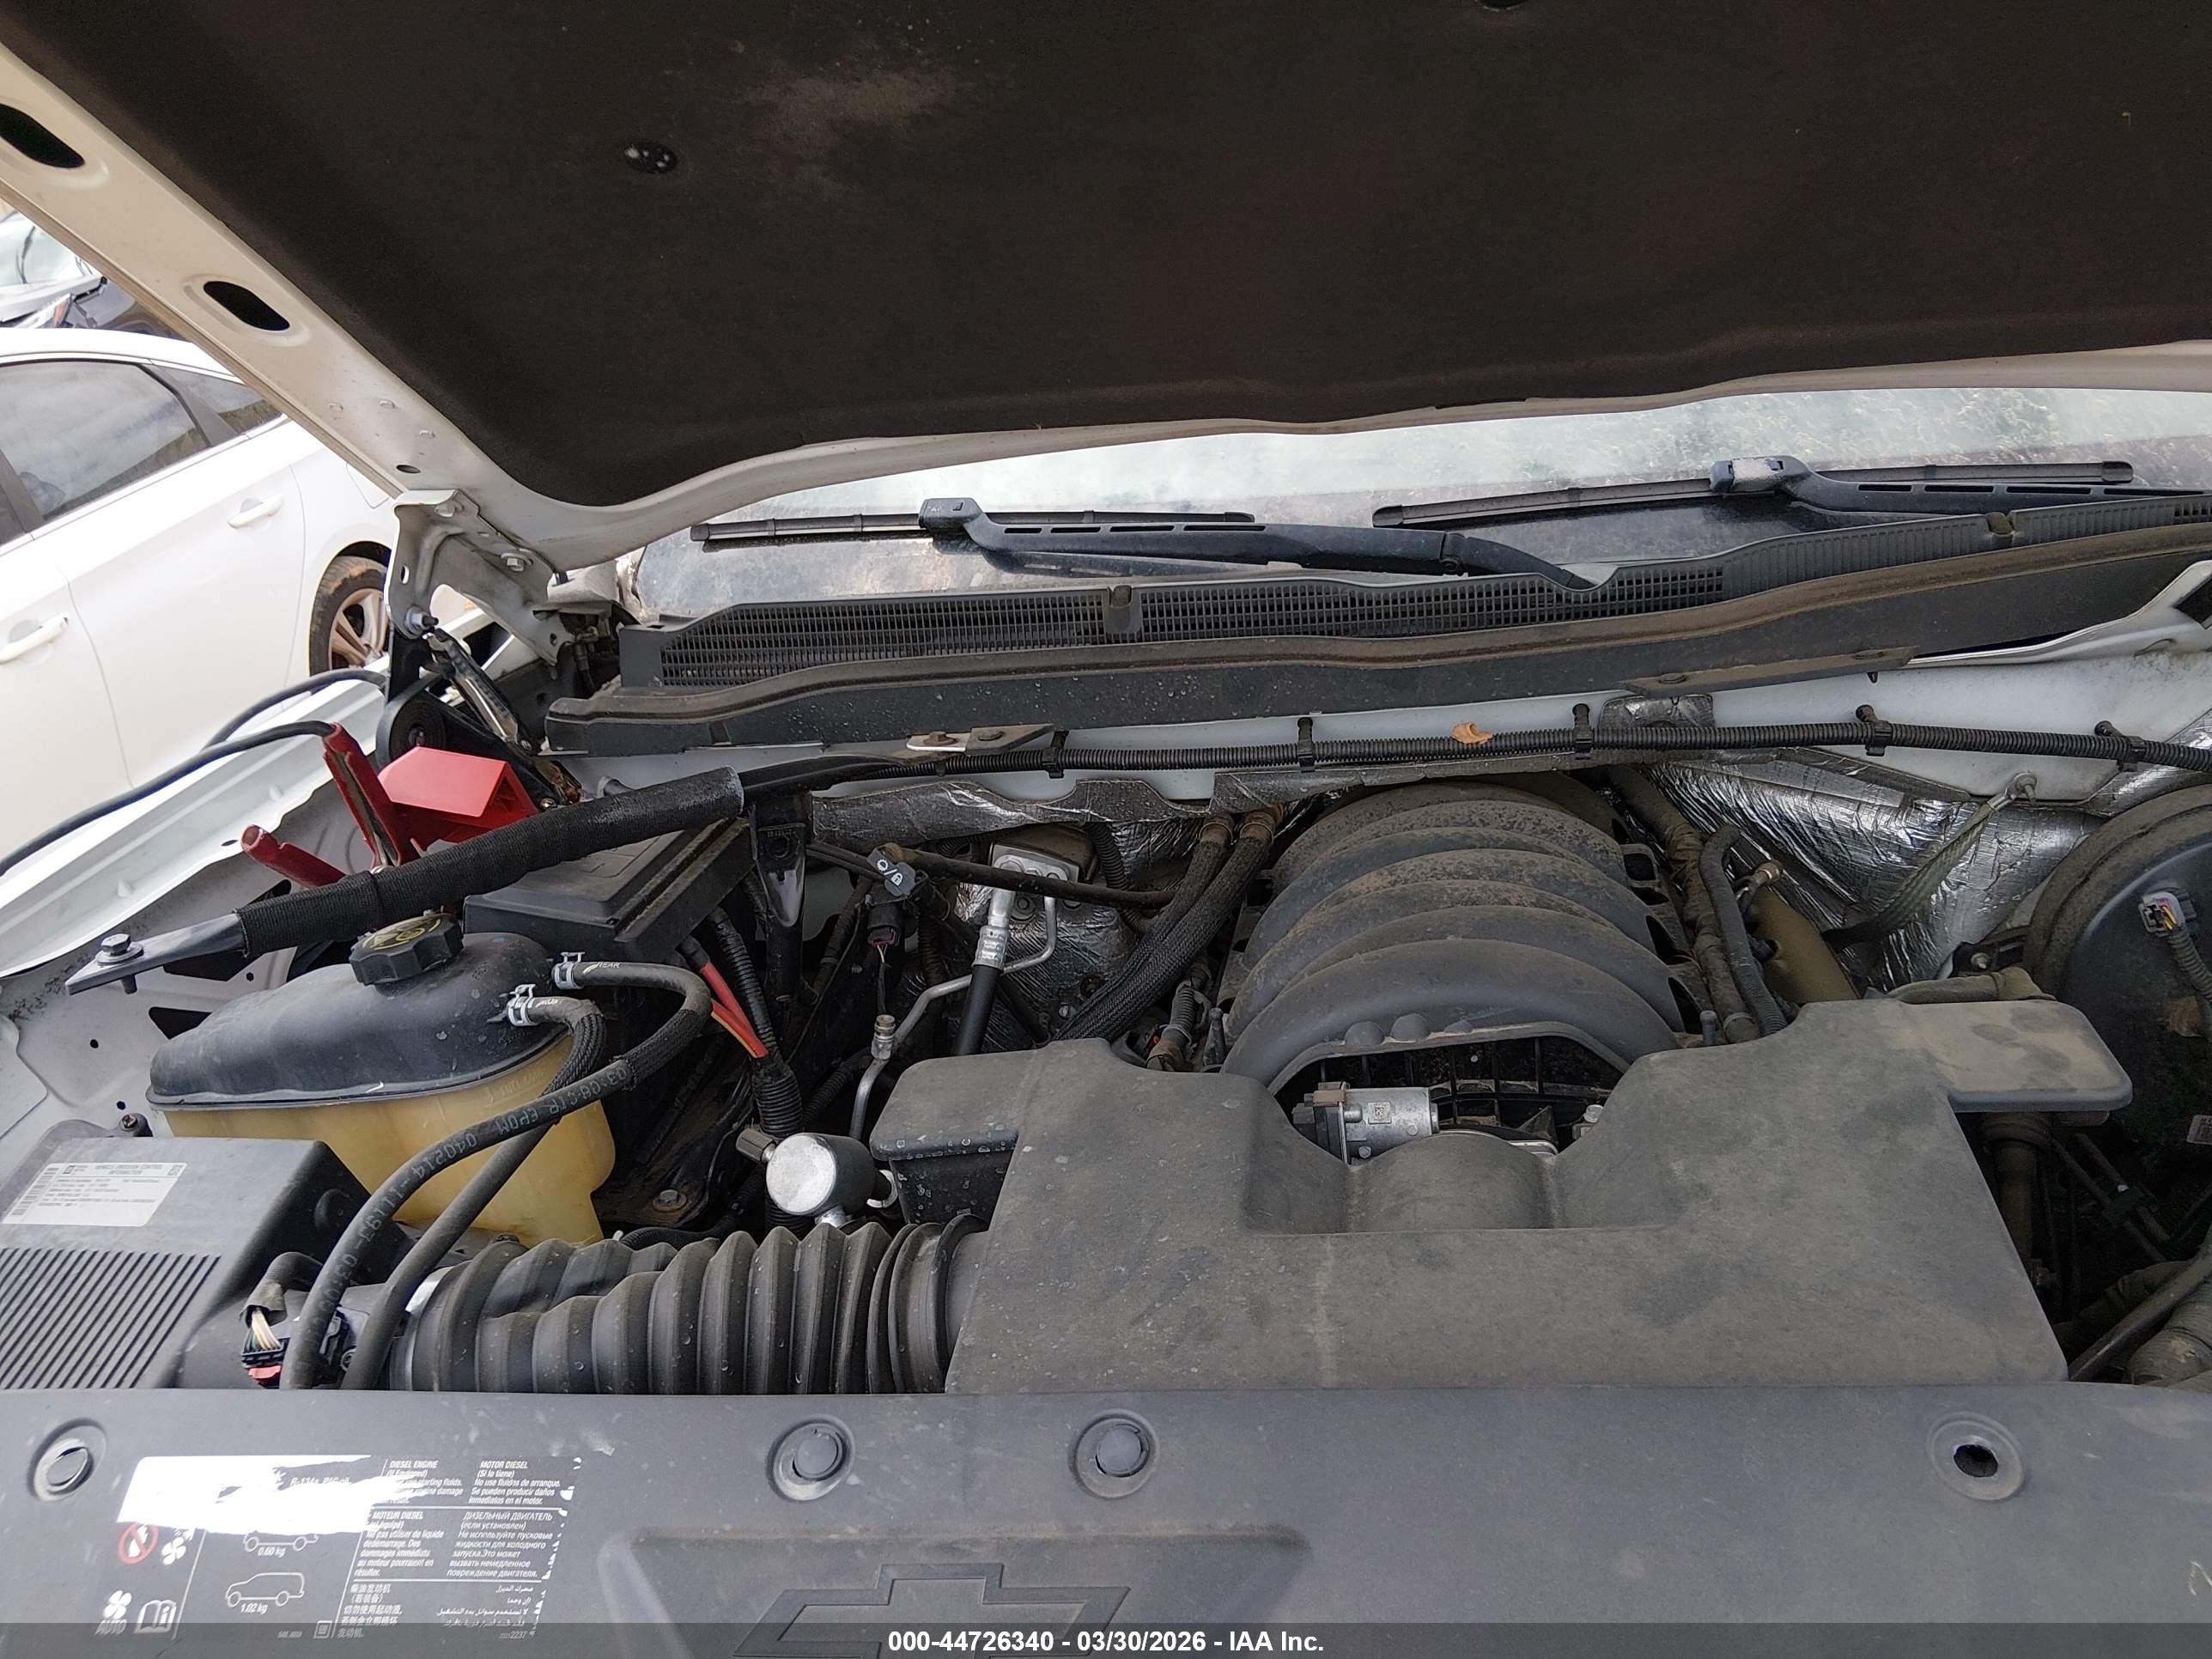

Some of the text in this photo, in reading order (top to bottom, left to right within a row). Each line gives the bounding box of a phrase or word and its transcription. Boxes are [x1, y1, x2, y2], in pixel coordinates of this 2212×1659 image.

[389, 1460, 439, 1468] DIESEL ENGINE
[504, 1461, 529, 1469] DIESEL
[495, 1469, 515, 1478] tiene)
[437, 1488, 464, 1497] damage
[481, 1487, 506, 1496] pueden
[468, 1496, 505, 1504] inmediatos
[371, 1510, 423, 1519] MOTEUR DIESEL
[463, 1510, 553, 1522] ДИЗЕЛЬНЫЙ ДВИГАТЕЛЬ
[460, 1521, 526, 1531] (если установлен)
[458, 1530, 470, 1539] Не
[470, 1531, 515, 1540] используйте
[455, 1540, 490, 1549] жидкости
[275, 1547, 286, 1559] kg
[447, 1569, 538, 1578] повреждение двигателя.
[240, 1602, 269, 1614] 1.02 kg
[94, 1619, 127, 1635] AUTO
